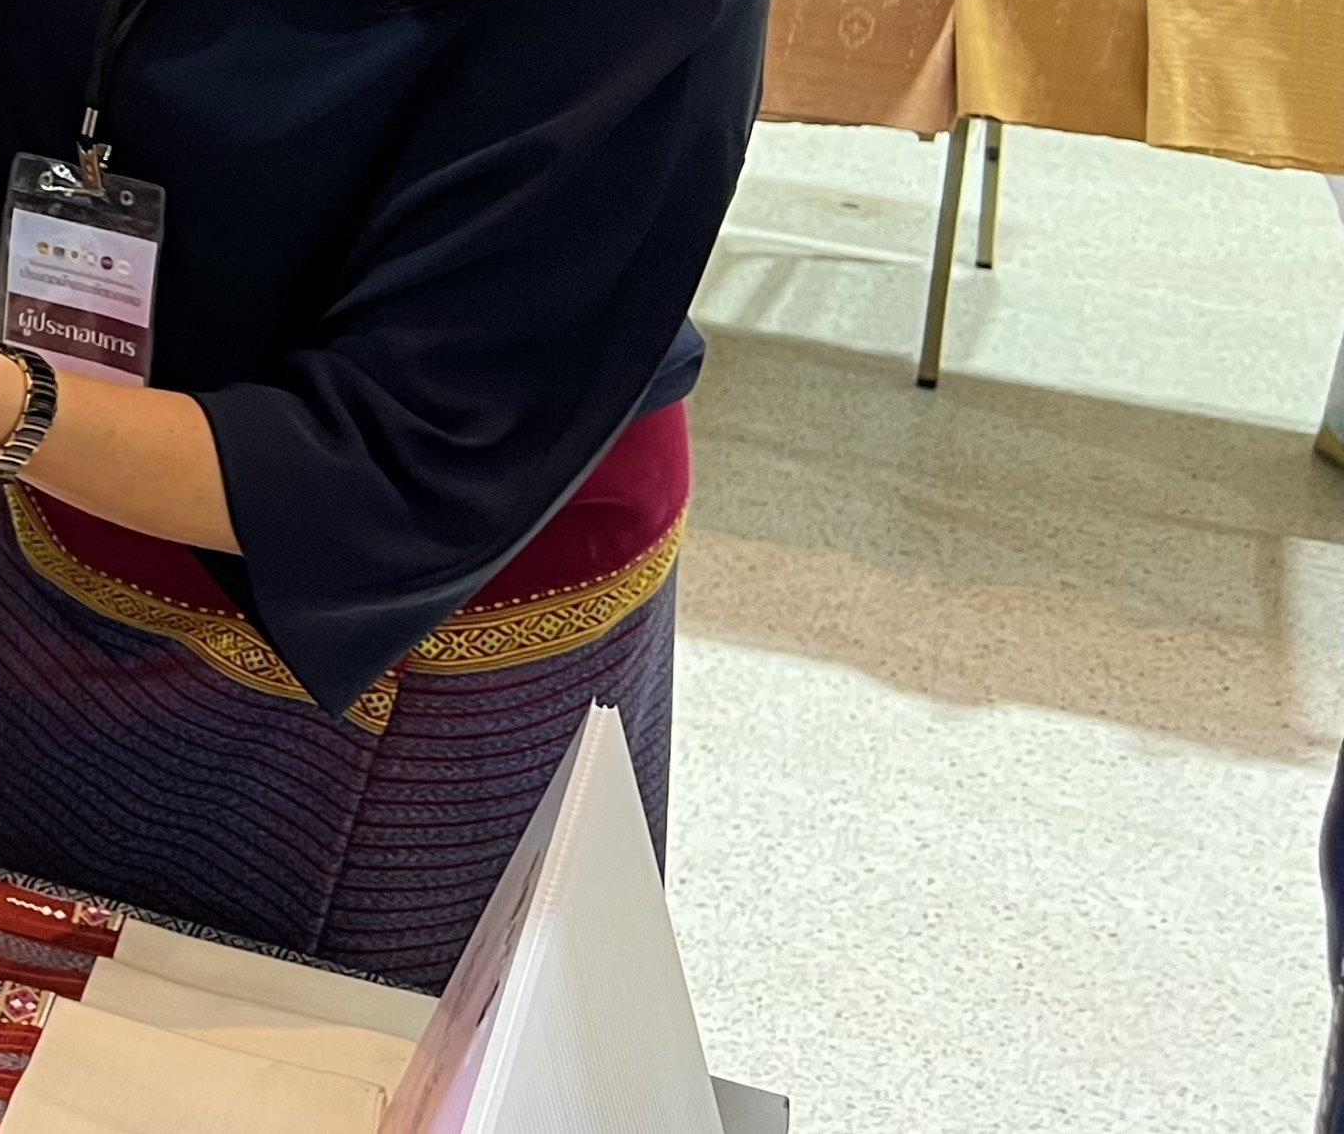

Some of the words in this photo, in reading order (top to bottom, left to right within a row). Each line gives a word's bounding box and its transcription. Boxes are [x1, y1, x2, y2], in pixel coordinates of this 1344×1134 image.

[17, 307, 137, 358] ผู้ประกอบการ
